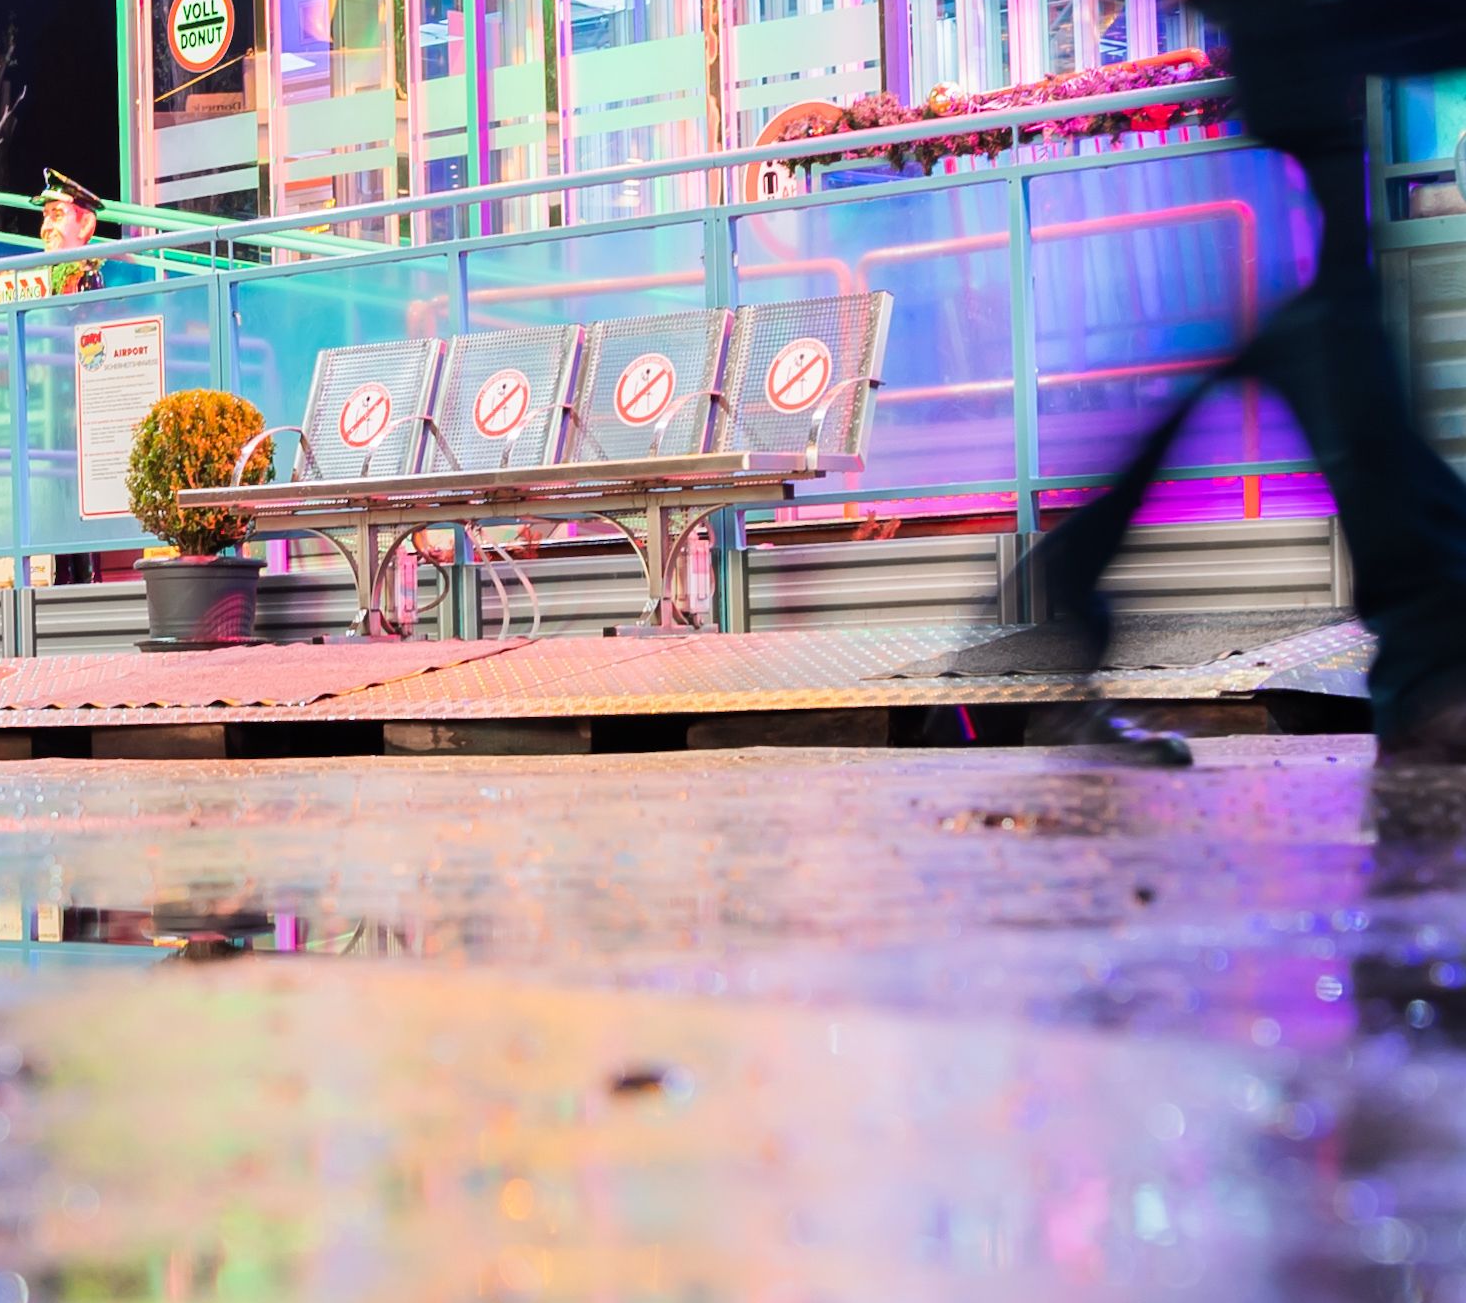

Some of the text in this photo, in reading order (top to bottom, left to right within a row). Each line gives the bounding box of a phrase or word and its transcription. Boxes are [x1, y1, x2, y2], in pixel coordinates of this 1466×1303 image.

[183, 0, 218, 21] VOLL
[181, 26, 222, 49] DONUT
[114, 346, 148, 357] AIRPORT
